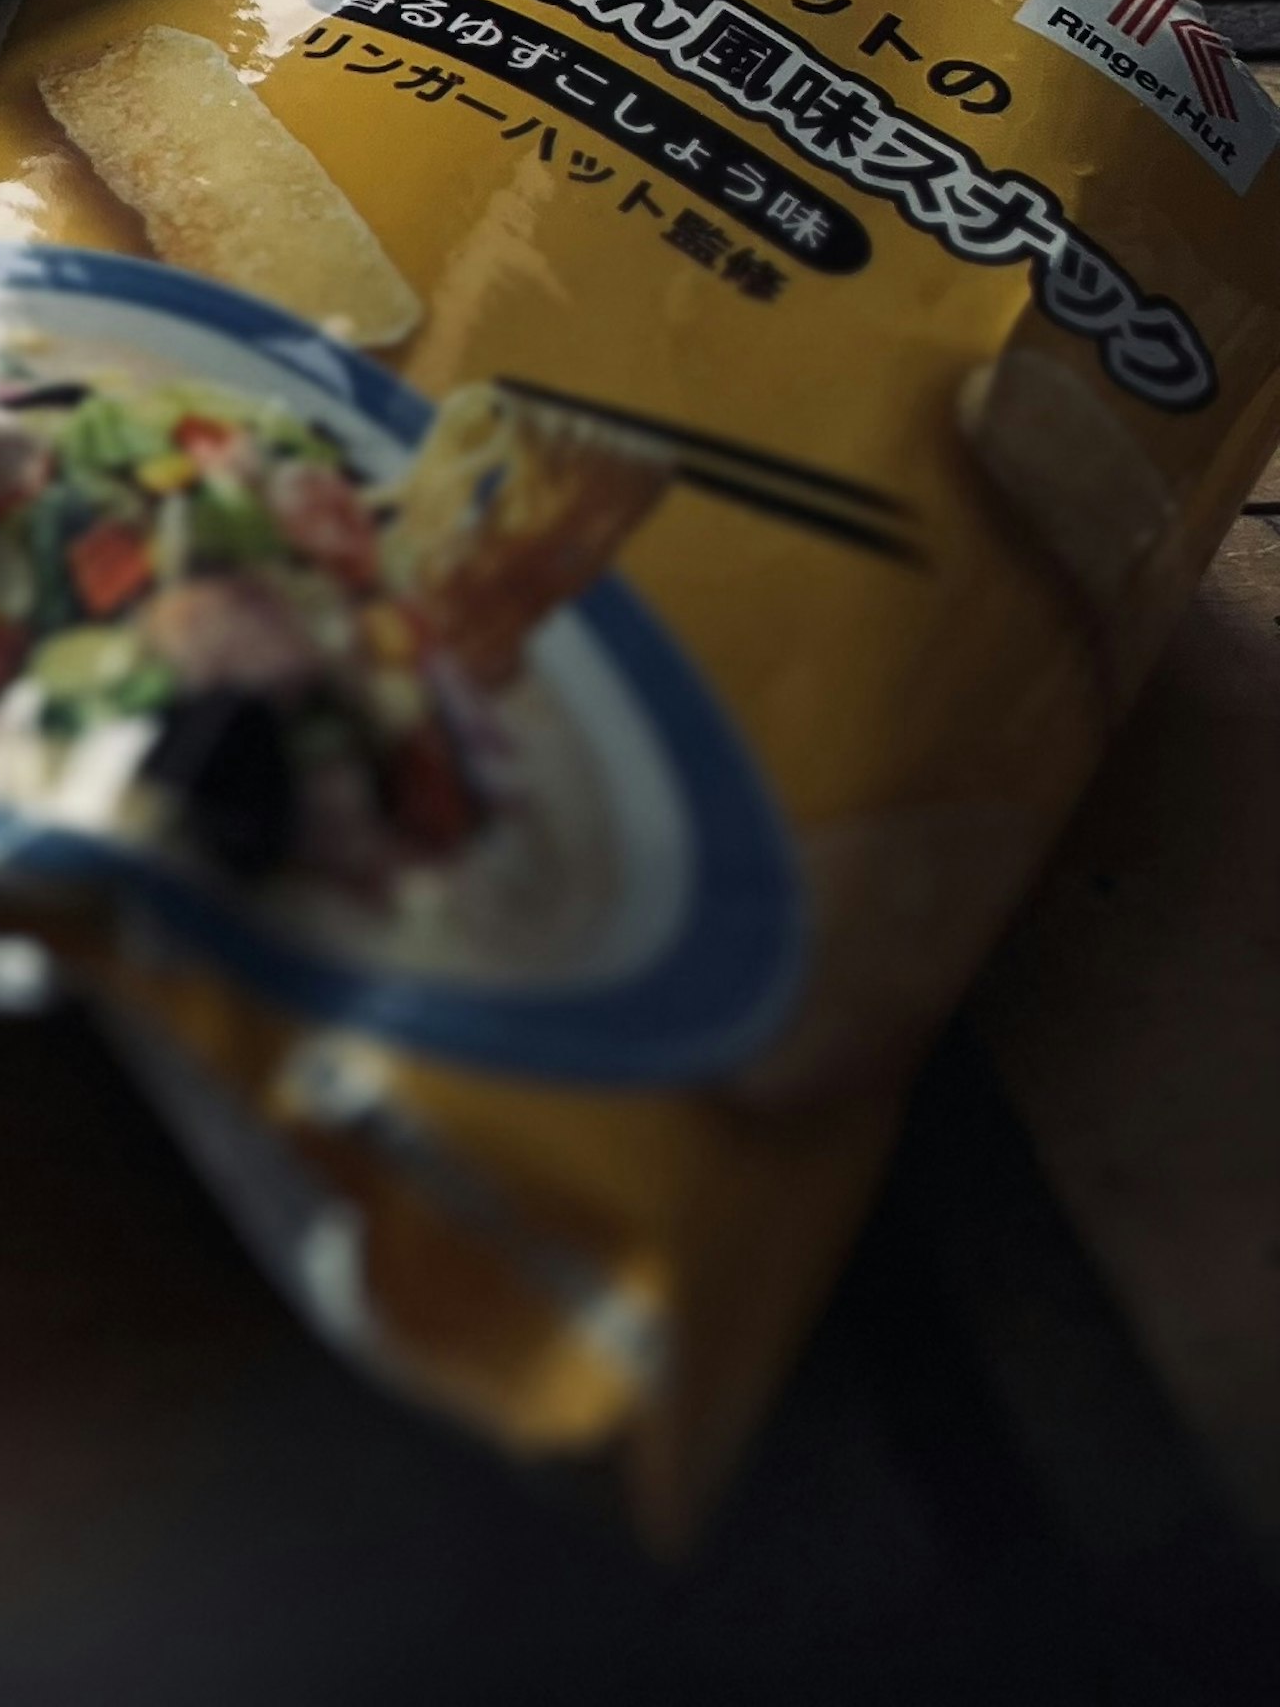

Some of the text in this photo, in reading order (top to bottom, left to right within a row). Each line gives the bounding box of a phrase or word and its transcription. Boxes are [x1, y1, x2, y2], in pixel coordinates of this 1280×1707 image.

[301, 25, 791, 306] リンガーハット監修
[1045, 4, 1239, 167] Ringer Hut
